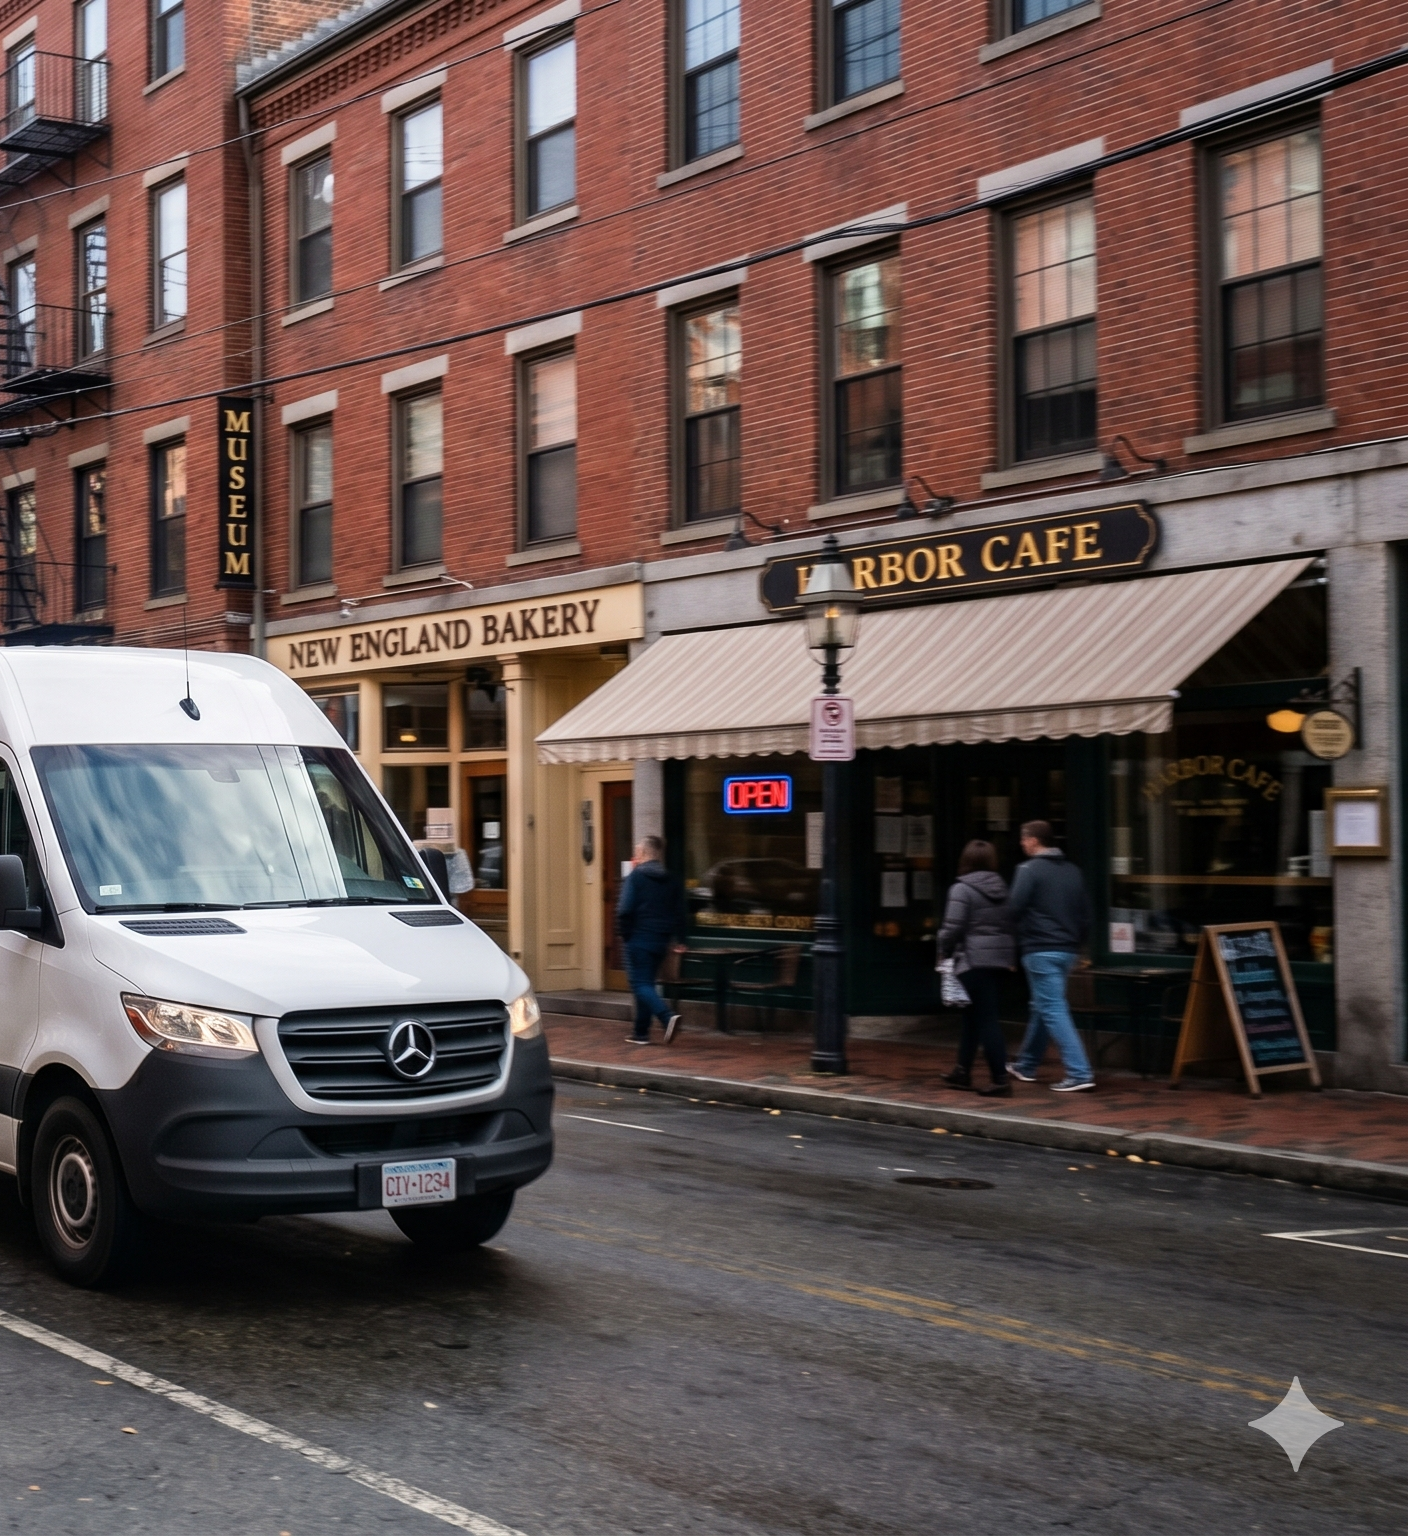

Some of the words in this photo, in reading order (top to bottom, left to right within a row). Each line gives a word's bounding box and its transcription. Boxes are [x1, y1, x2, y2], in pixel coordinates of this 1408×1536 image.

[224, 410, 251, 575] MUSEUM
[797, 544, 967, 595] HRBOR
[981, 521, 1103, 572] CAFE
[289, 636, 341, 669] NEW
[349, 618, 471, 662] ENGLAND
[481, 599, 600, 645] BAKERY
[728, 780, 789, 808] OPEN
[1227, 759, 1283, 801] CAFE
